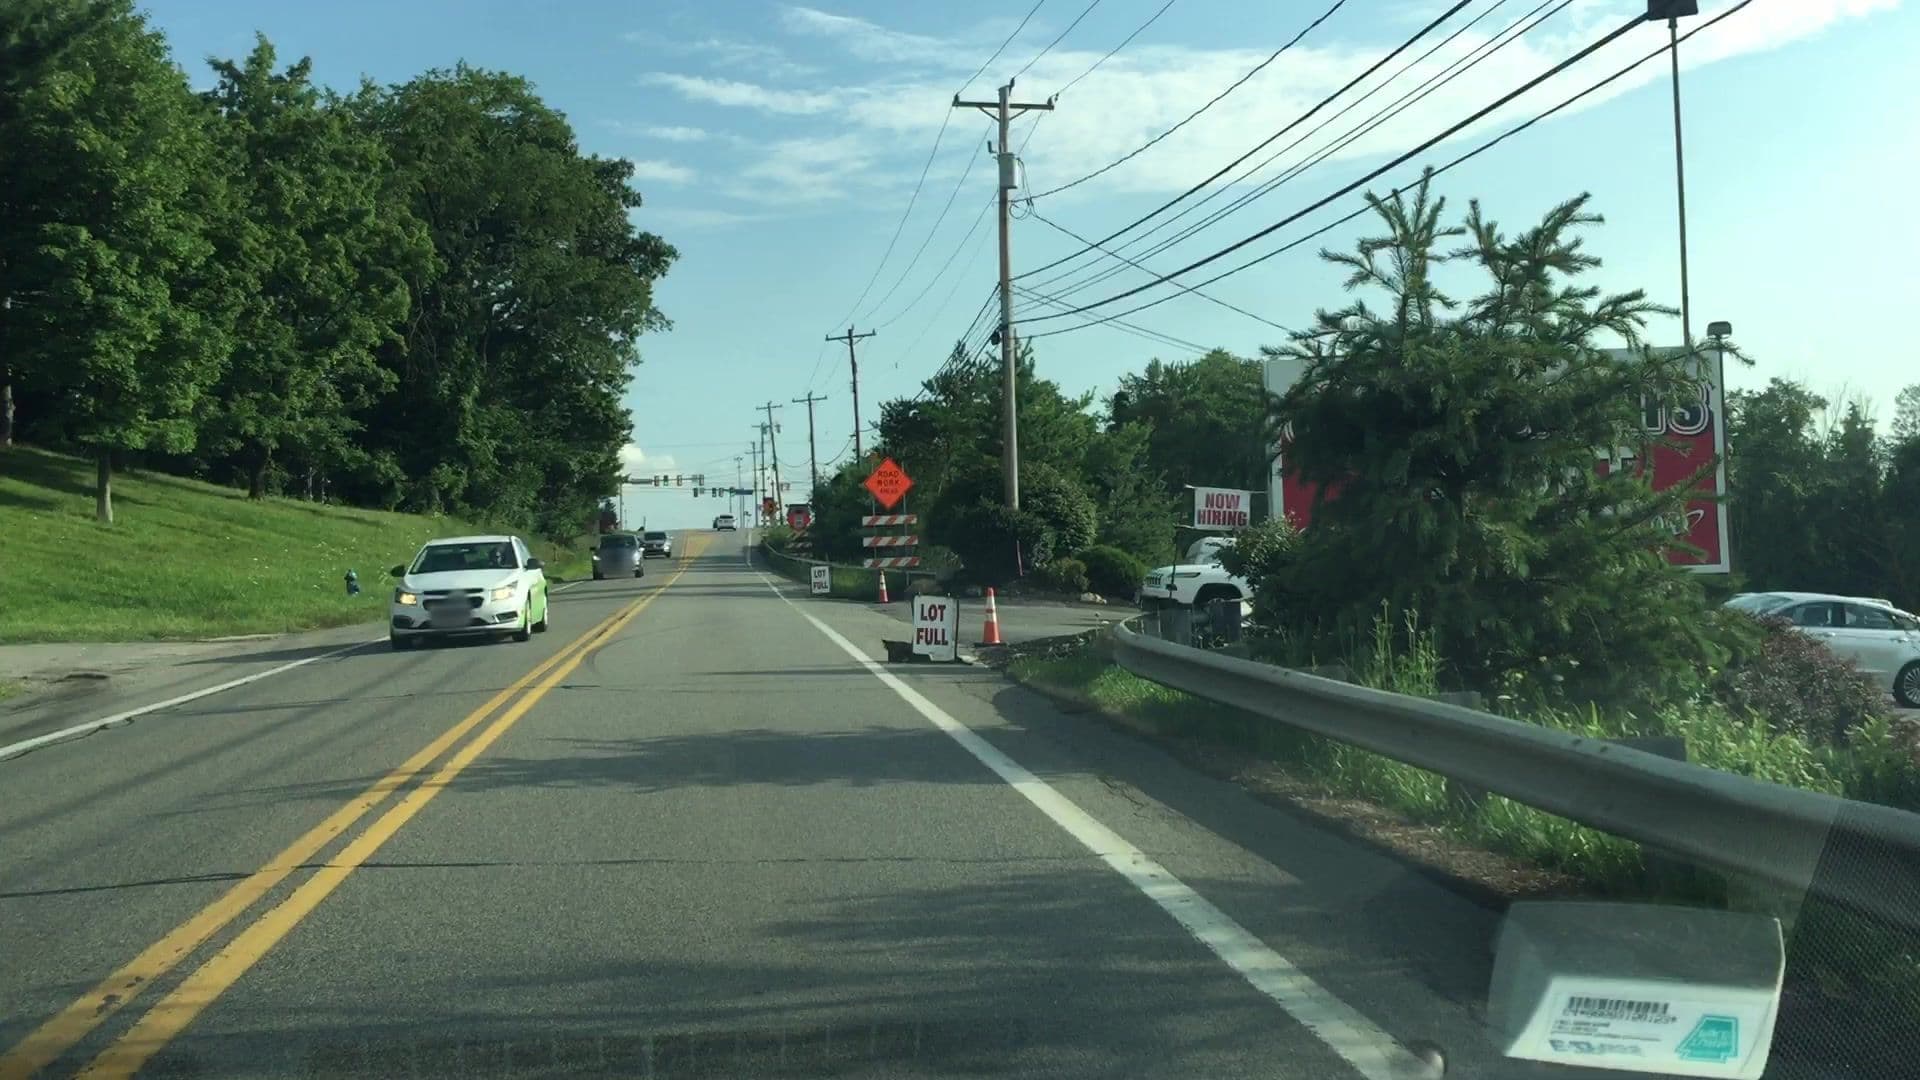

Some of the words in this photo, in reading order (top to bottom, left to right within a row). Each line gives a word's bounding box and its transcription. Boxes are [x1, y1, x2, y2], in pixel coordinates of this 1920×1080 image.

[877, 479, 899, 487] WORK
[1205, 493, 1240, 509] NOW
[1197, 509, 1248, 526] HIRING
[814, 569, 826, 578] LOT
[813, 581, 828, 590] FULL
[920, 604, 946, 622] LOT
[916, 627, 949, 646] FULL
